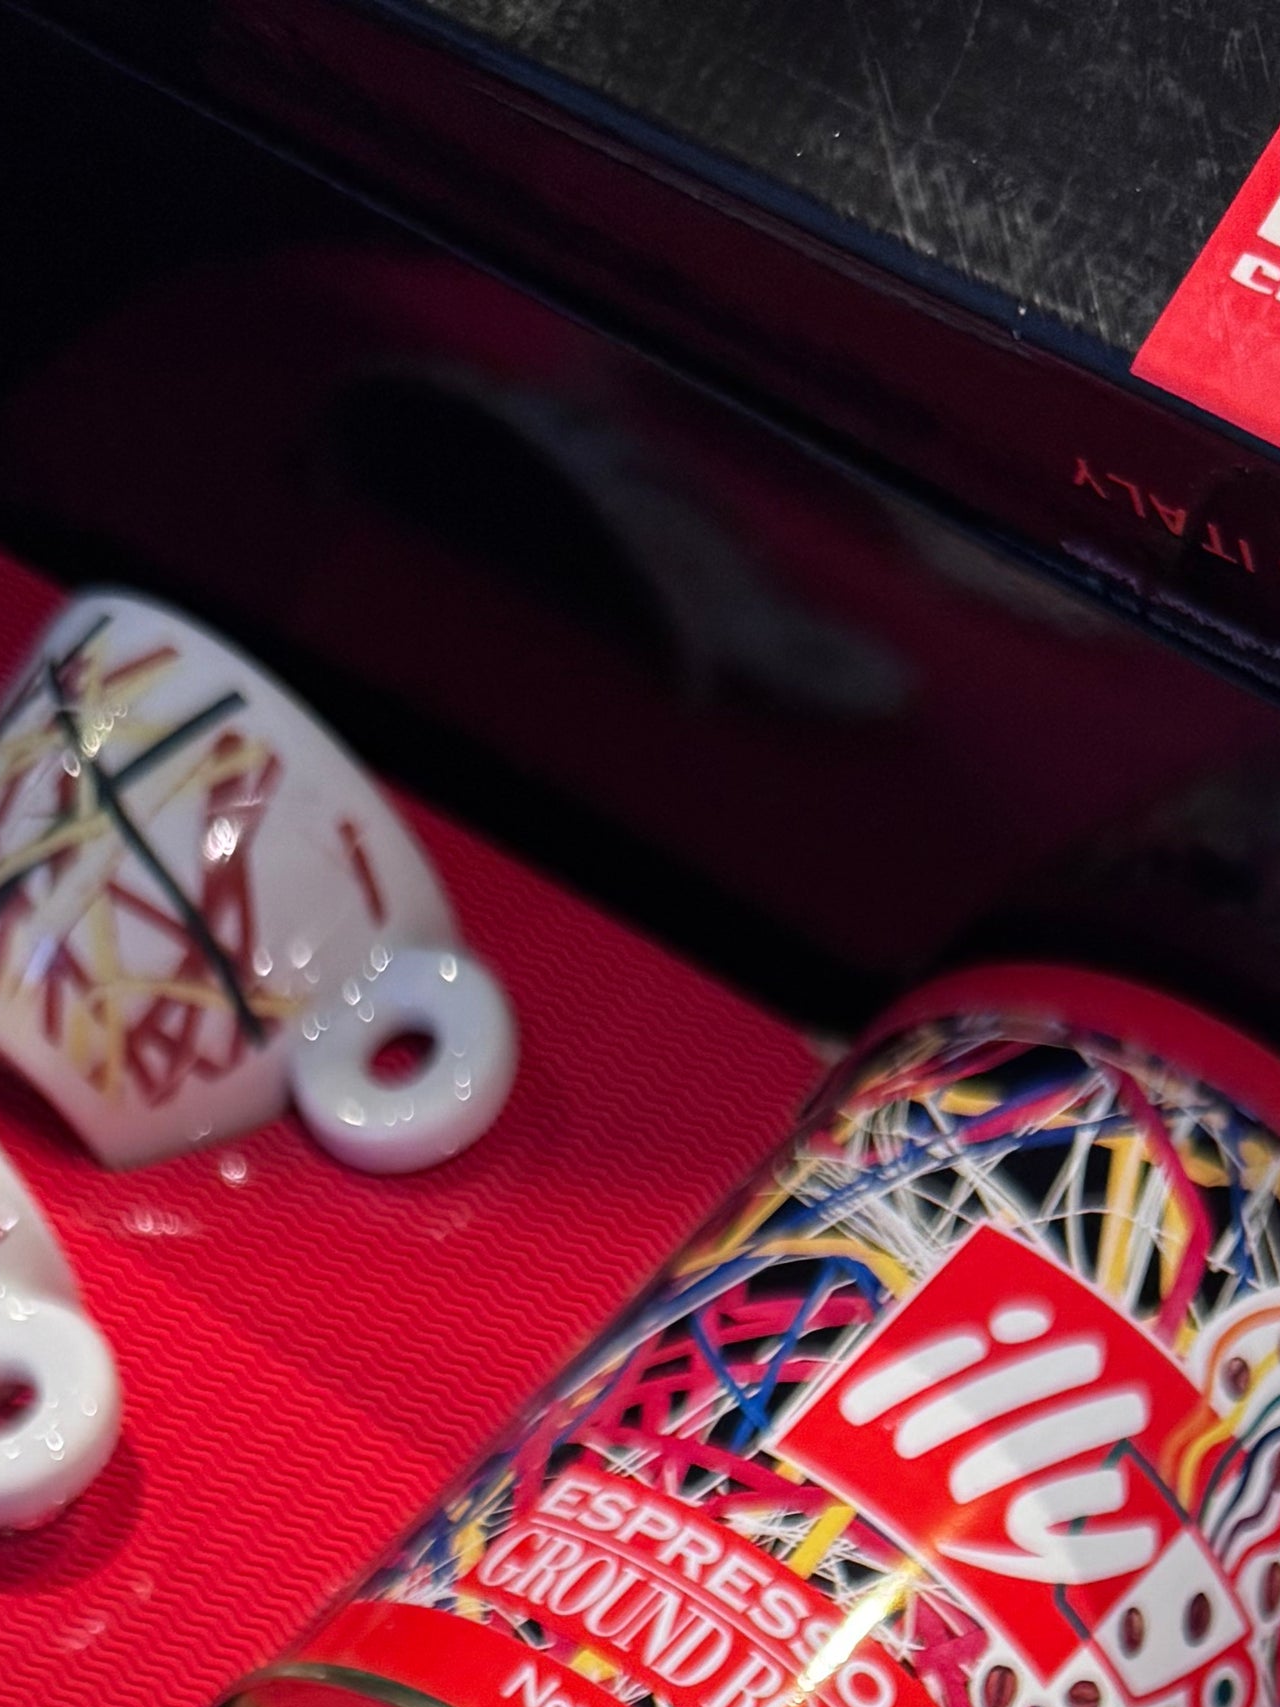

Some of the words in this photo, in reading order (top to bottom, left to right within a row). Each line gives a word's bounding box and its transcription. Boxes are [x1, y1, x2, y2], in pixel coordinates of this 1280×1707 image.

[1073, 457, 1256, 573] ITALY
[838, 1307, 1160, 1586] illy
[477, 1526, 731, 1704] GROUND
